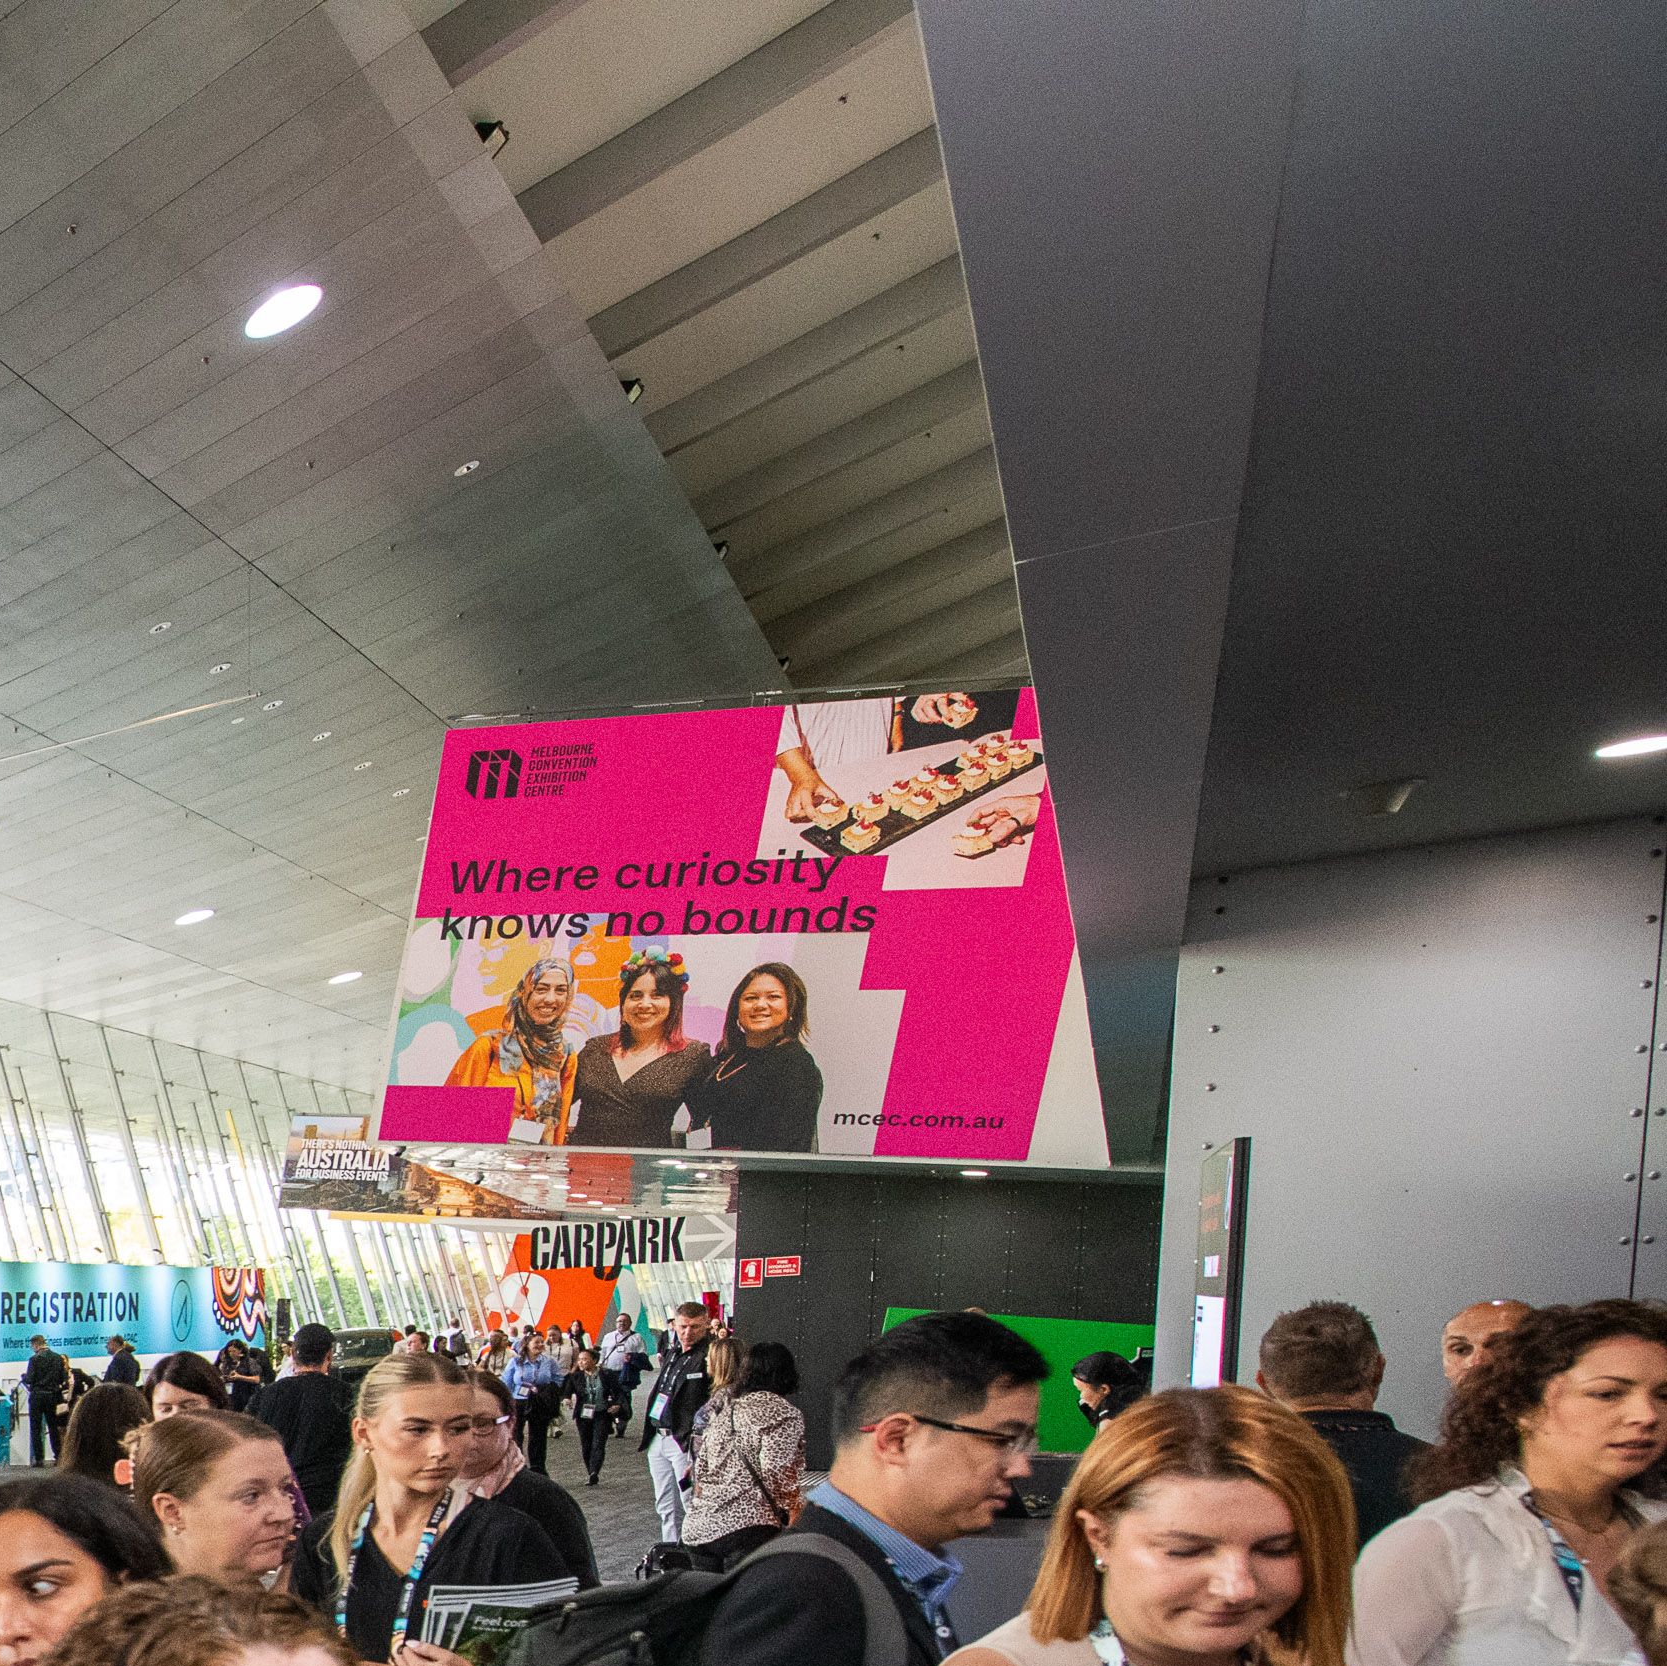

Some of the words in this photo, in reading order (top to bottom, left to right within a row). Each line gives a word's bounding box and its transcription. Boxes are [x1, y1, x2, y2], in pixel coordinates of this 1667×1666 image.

[530, 744, 595, 758] MELBOURNE
[528, 756, 598, 772] CONVENTION
[526, 770, 588, 785] EXHIBITION
[524, 784, 565, 798] CENTRE
[450, 860, 599, 894] Where
[615, 849, 845, 893] curiosity
[439, 908, 591, 941] knows
[606, 909, 665, 936] no
[683, 896, 879, 936] bounds
[833, 1112, 1005, 1130] mcec.com.au
[300, 1138, 334, 1150] THERE'S
[335, 1139, 374, 1151] NOTHIN
[296, 1149, 391, 1172] AUSTRALIA
[295, 1169, 308, 1182] FOR
[308, 1169, 355, 1182] BUSINESS
[355, 1169, 389, 1182] EVENTS
[530, 1216, 686, 1281] CARPARK
[0, 1291, 139, 1324] REGISTRATION
[3, 1337, 24, 1348] Where
[63, 1335, 82, 1346] events
[82, 1334, 99, 1346] world
[473, 1615, 503, 1626] Feel
